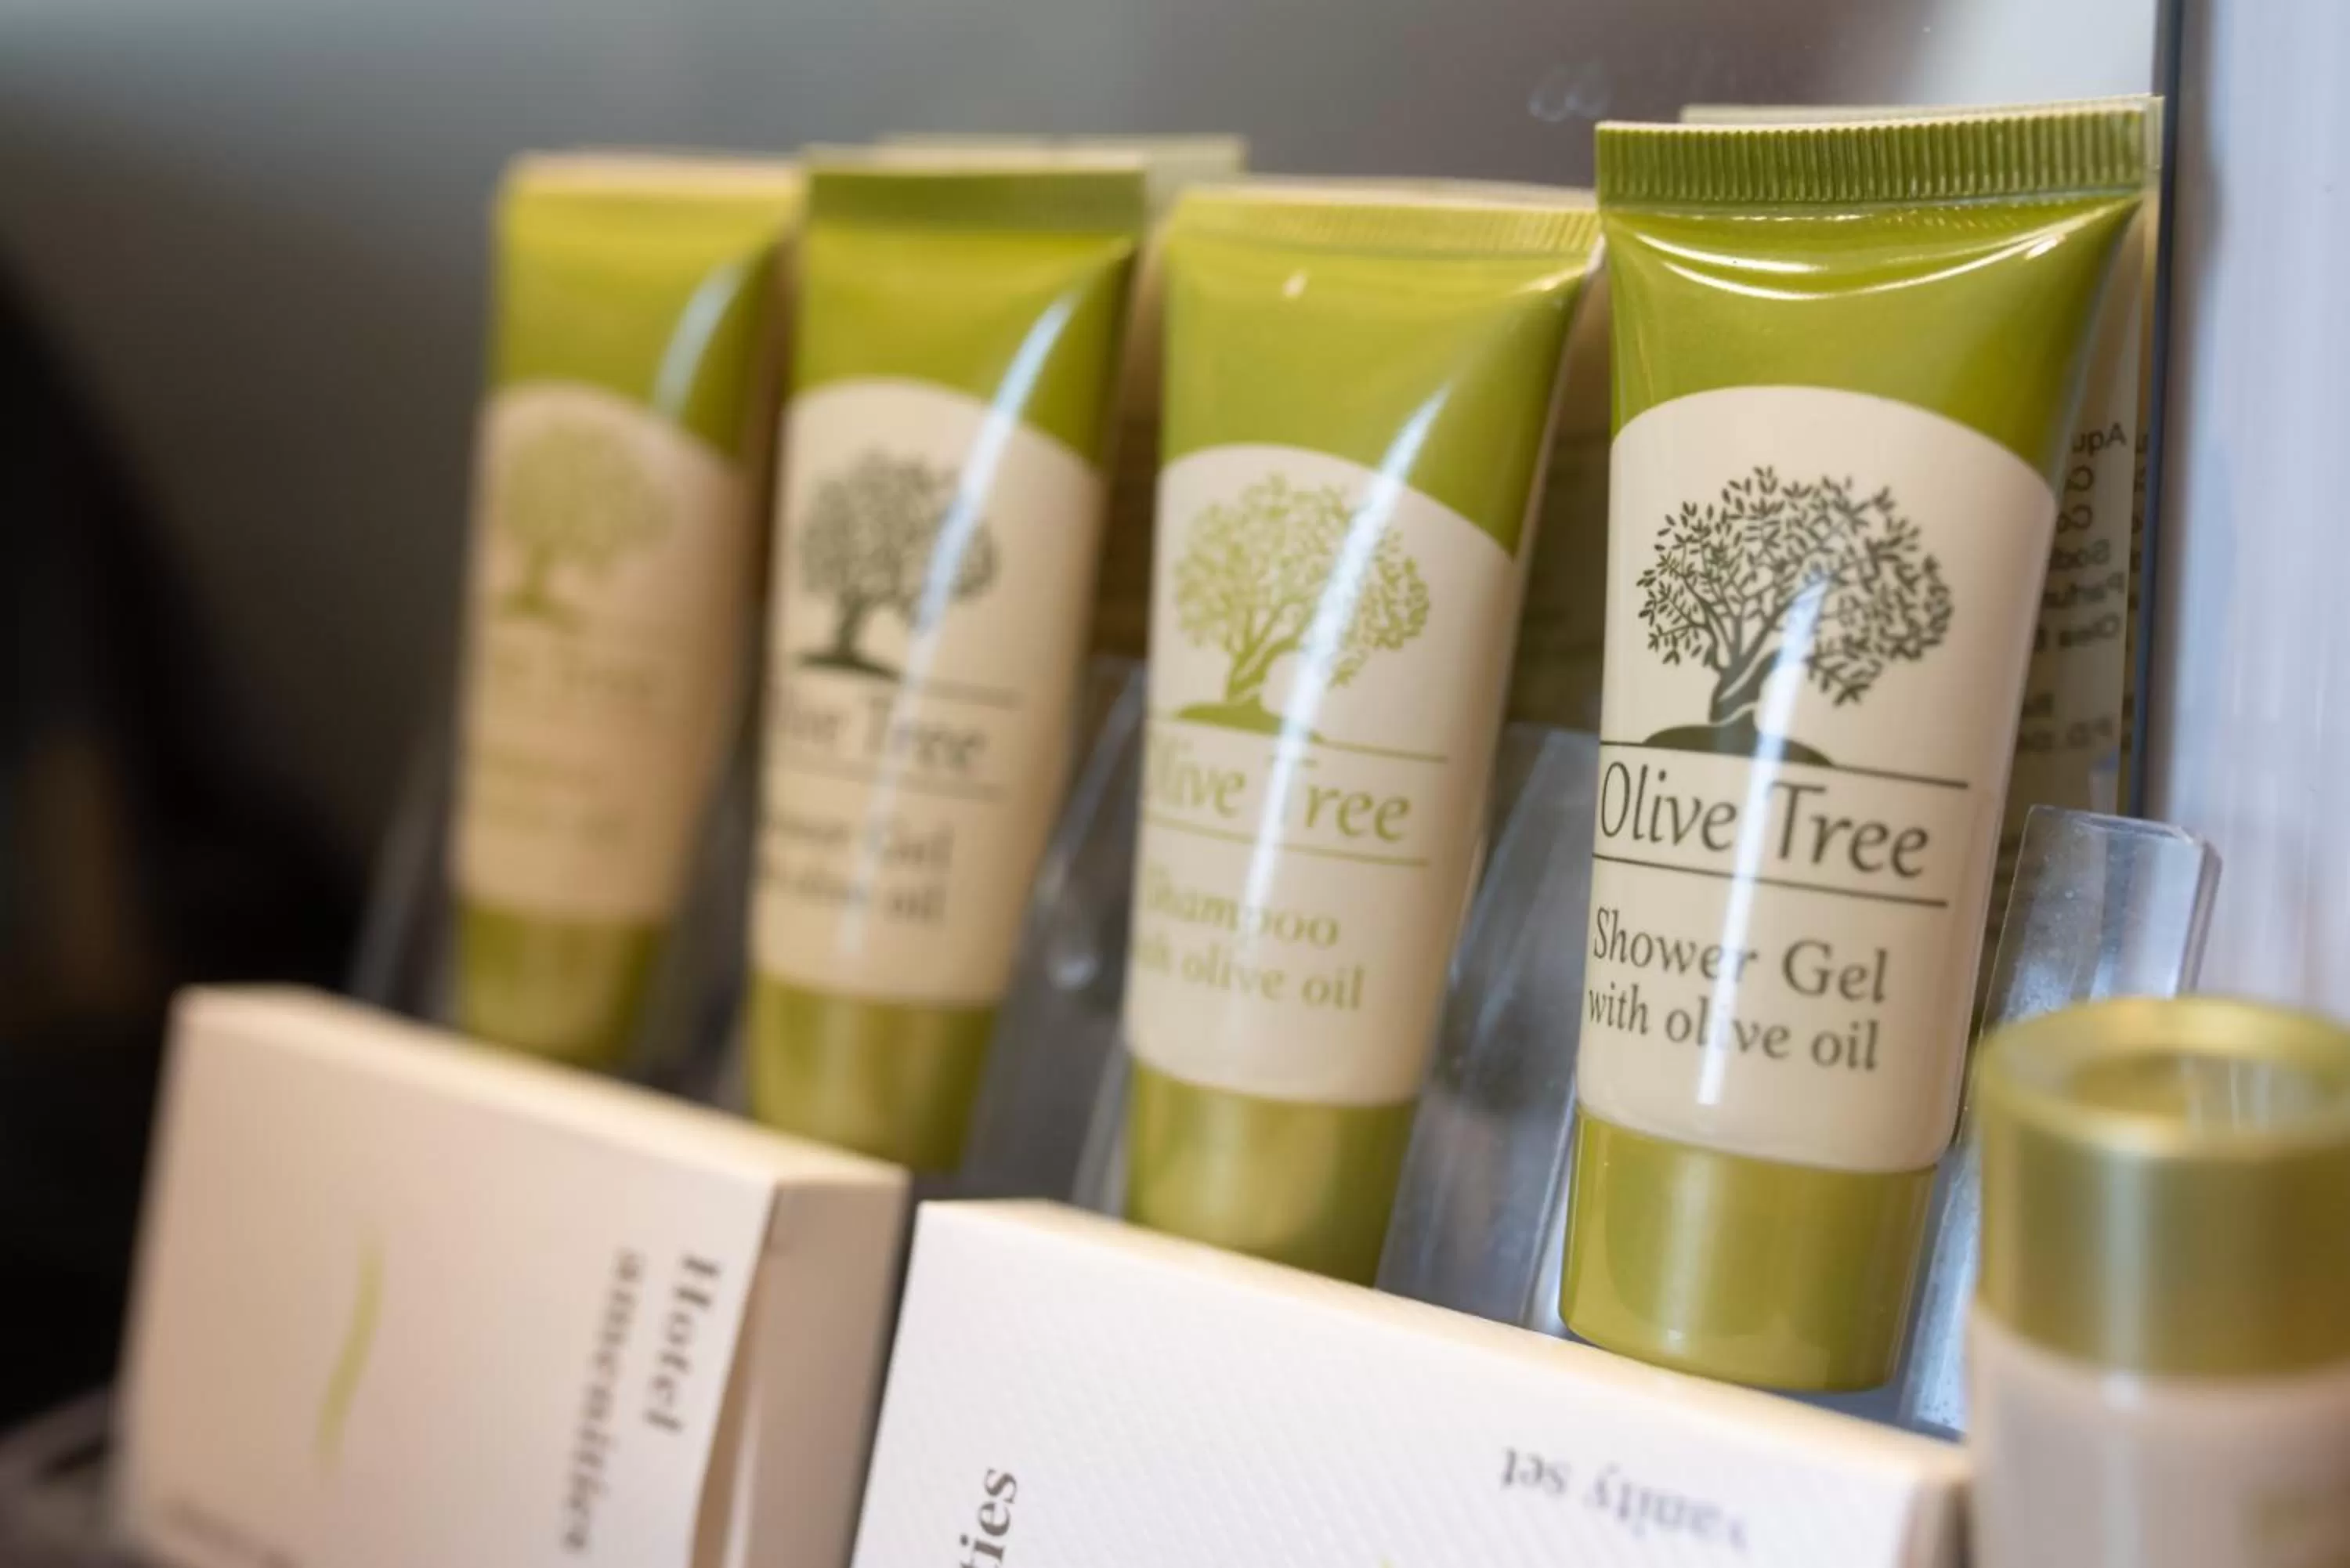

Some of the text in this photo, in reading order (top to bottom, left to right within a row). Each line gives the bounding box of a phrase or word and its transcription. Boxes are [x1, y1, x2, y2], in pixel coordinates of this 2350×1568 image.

[1147, 735, 1412, 843] live ree
[1600, 761, 1929, 879] Olive Tree
[1300, 964, 1366, 1012] oil
[1593, 906, 1889, 1004] Shower Gel
[1589, 982, 1879, 1071] with olve oil
[641, 1252, 725, 1438] Hotel
[959, 1466, 1018, 1568] ies
[1502, 1446, 1571, 1495] set
